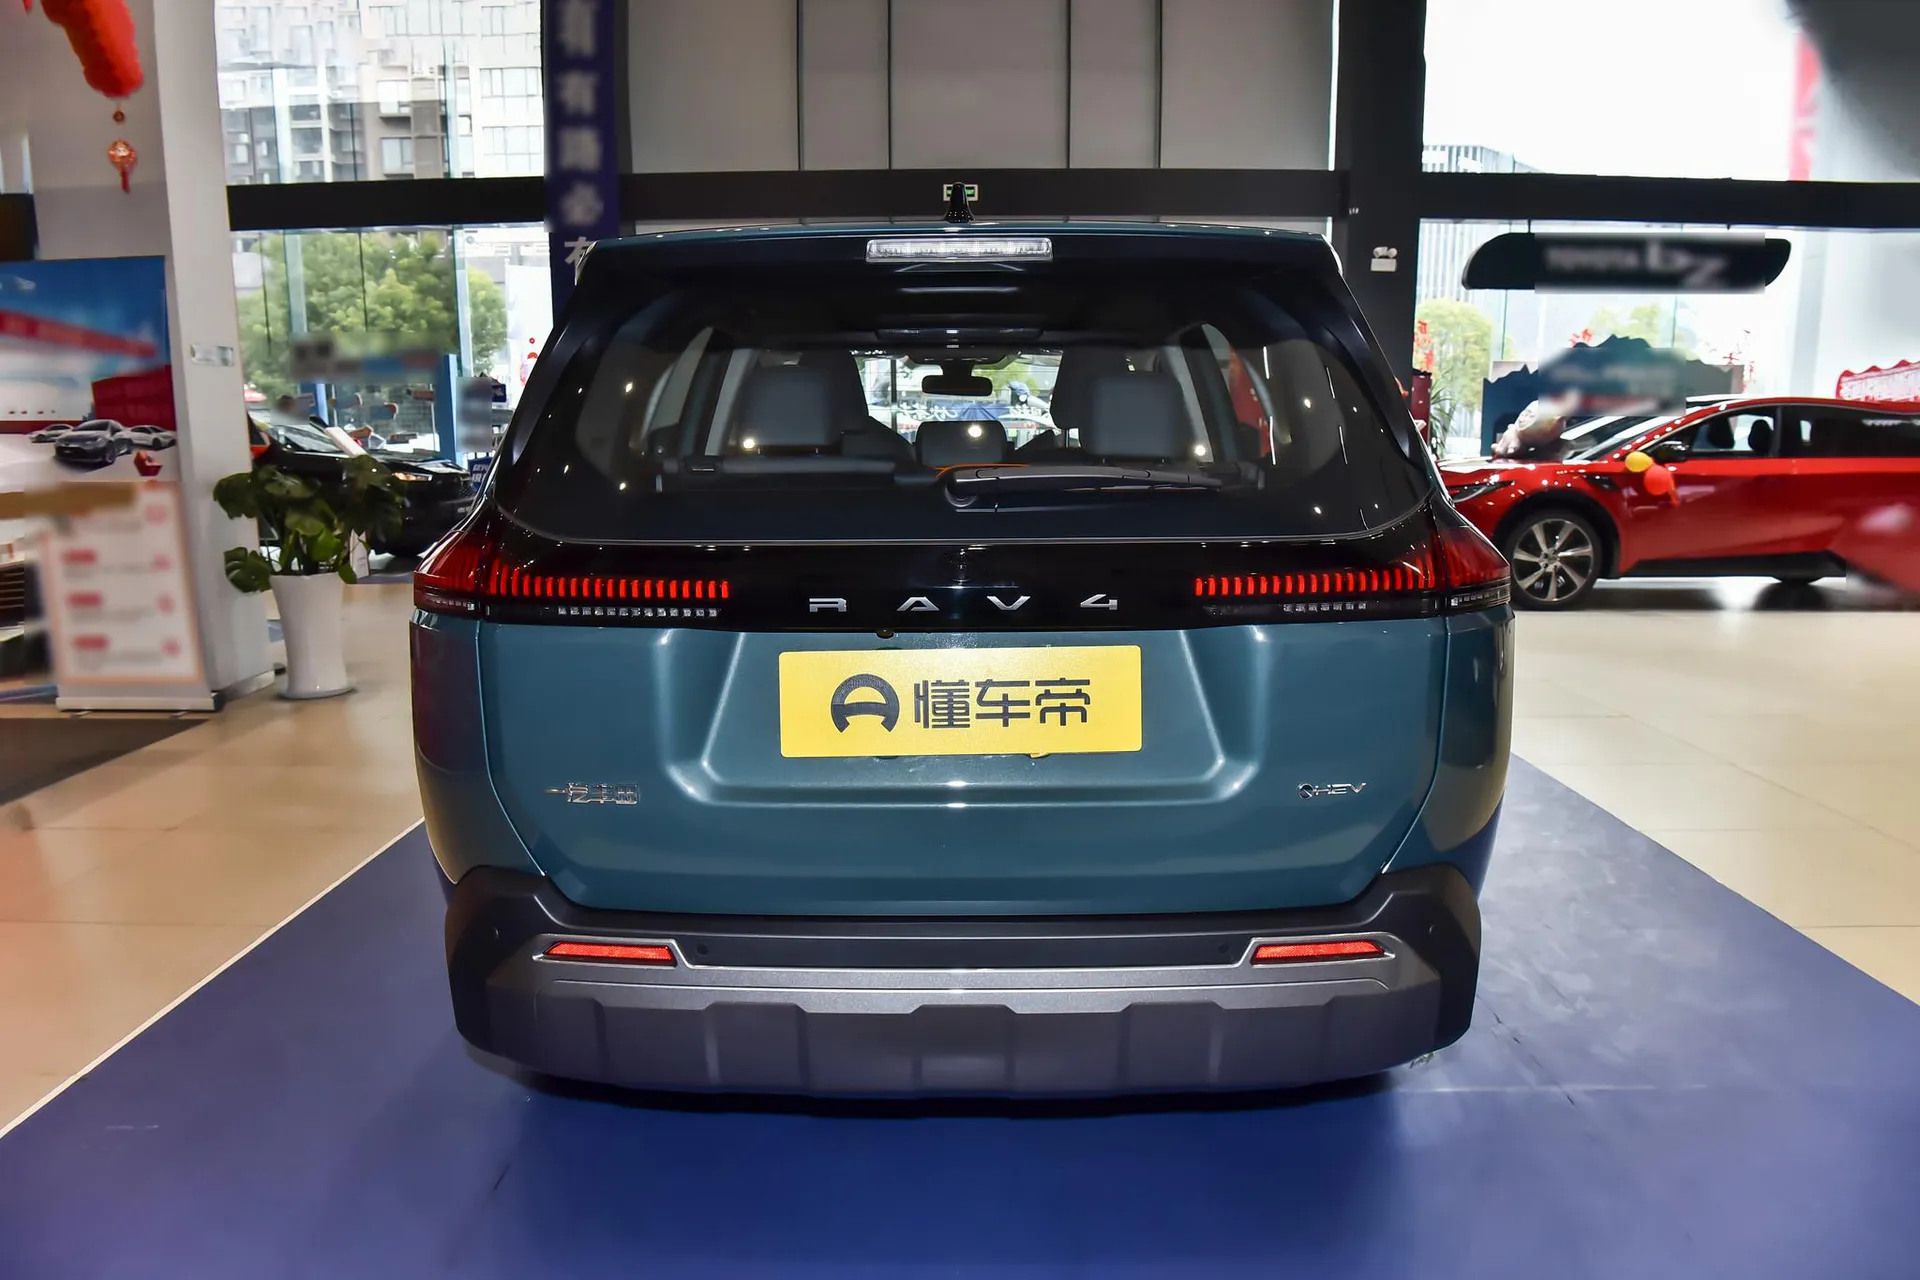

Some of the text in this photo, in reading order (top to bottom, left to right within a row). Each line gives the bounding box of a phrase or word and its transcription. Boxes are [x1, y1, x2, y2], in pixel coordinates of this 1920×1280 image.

[808, 594, 1119, 613] RAV4
[913, 677, 1092, 730] 懂车帝
